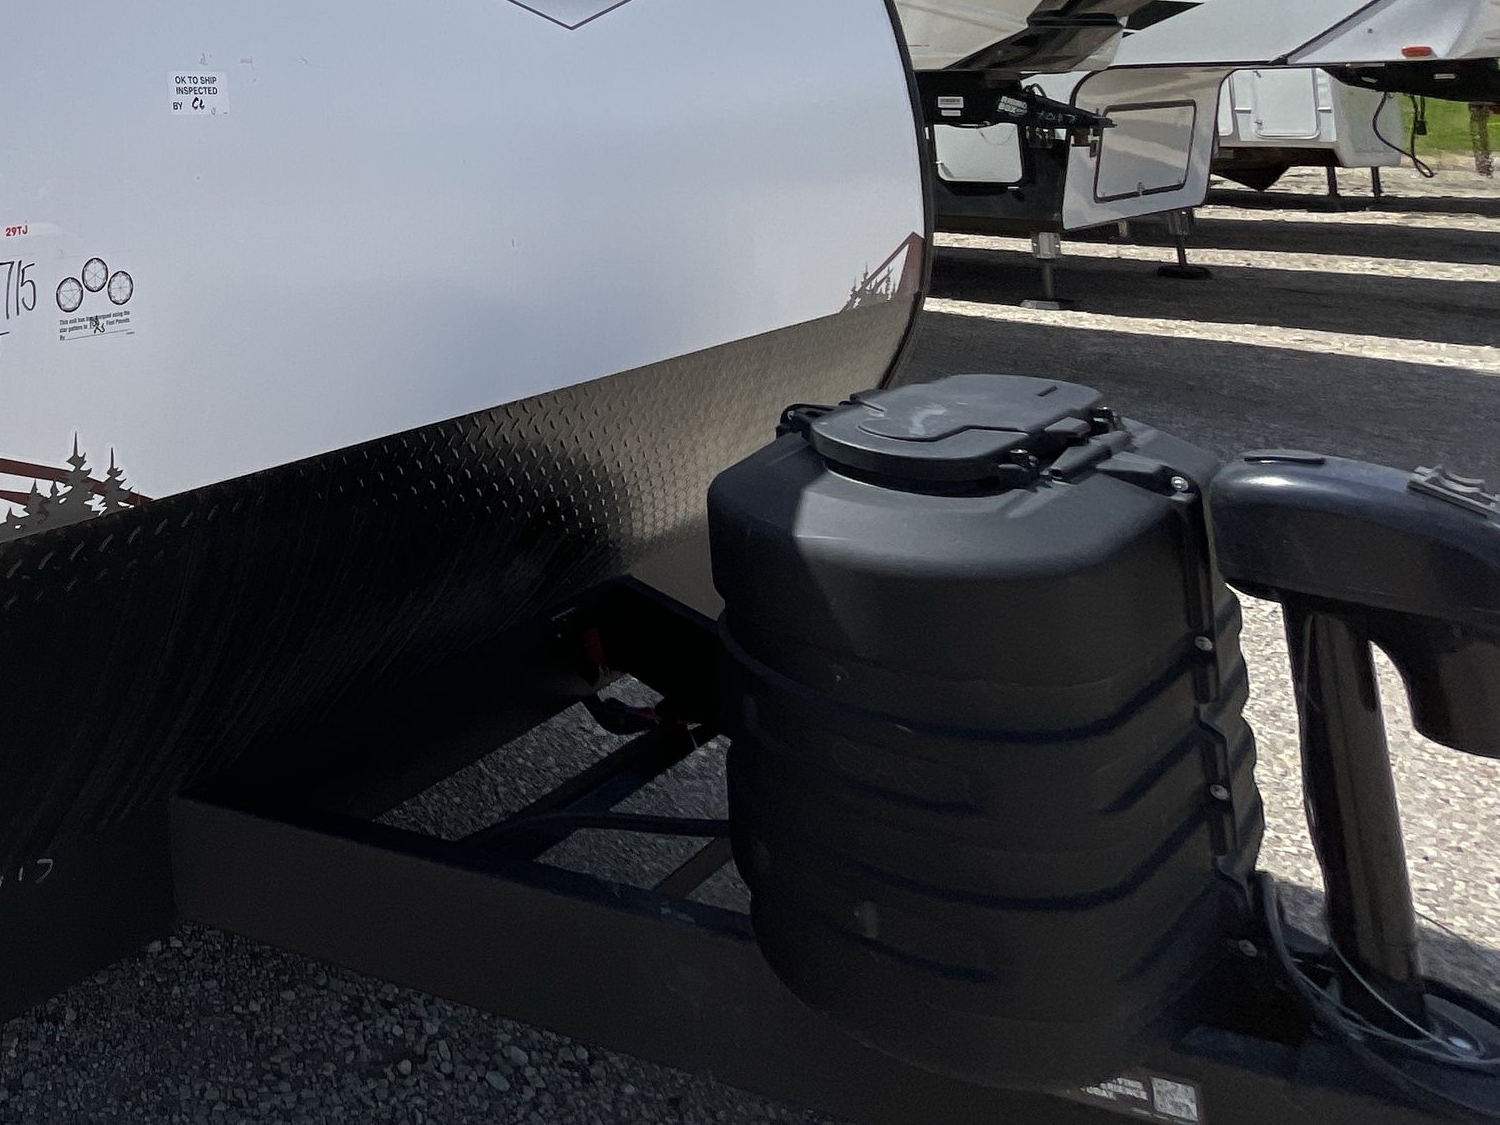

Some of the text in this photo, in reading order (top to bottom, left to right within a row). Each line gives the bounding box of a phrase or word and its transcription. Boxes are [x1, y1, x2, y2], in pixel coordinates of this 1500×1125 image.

[174, 75, 217, 85] OK TO SHIP
[176, 86, 218, 95] INSPECTED
[172, 101, 183, 110] BY
[5, 225, 28, 237] 29TJ
